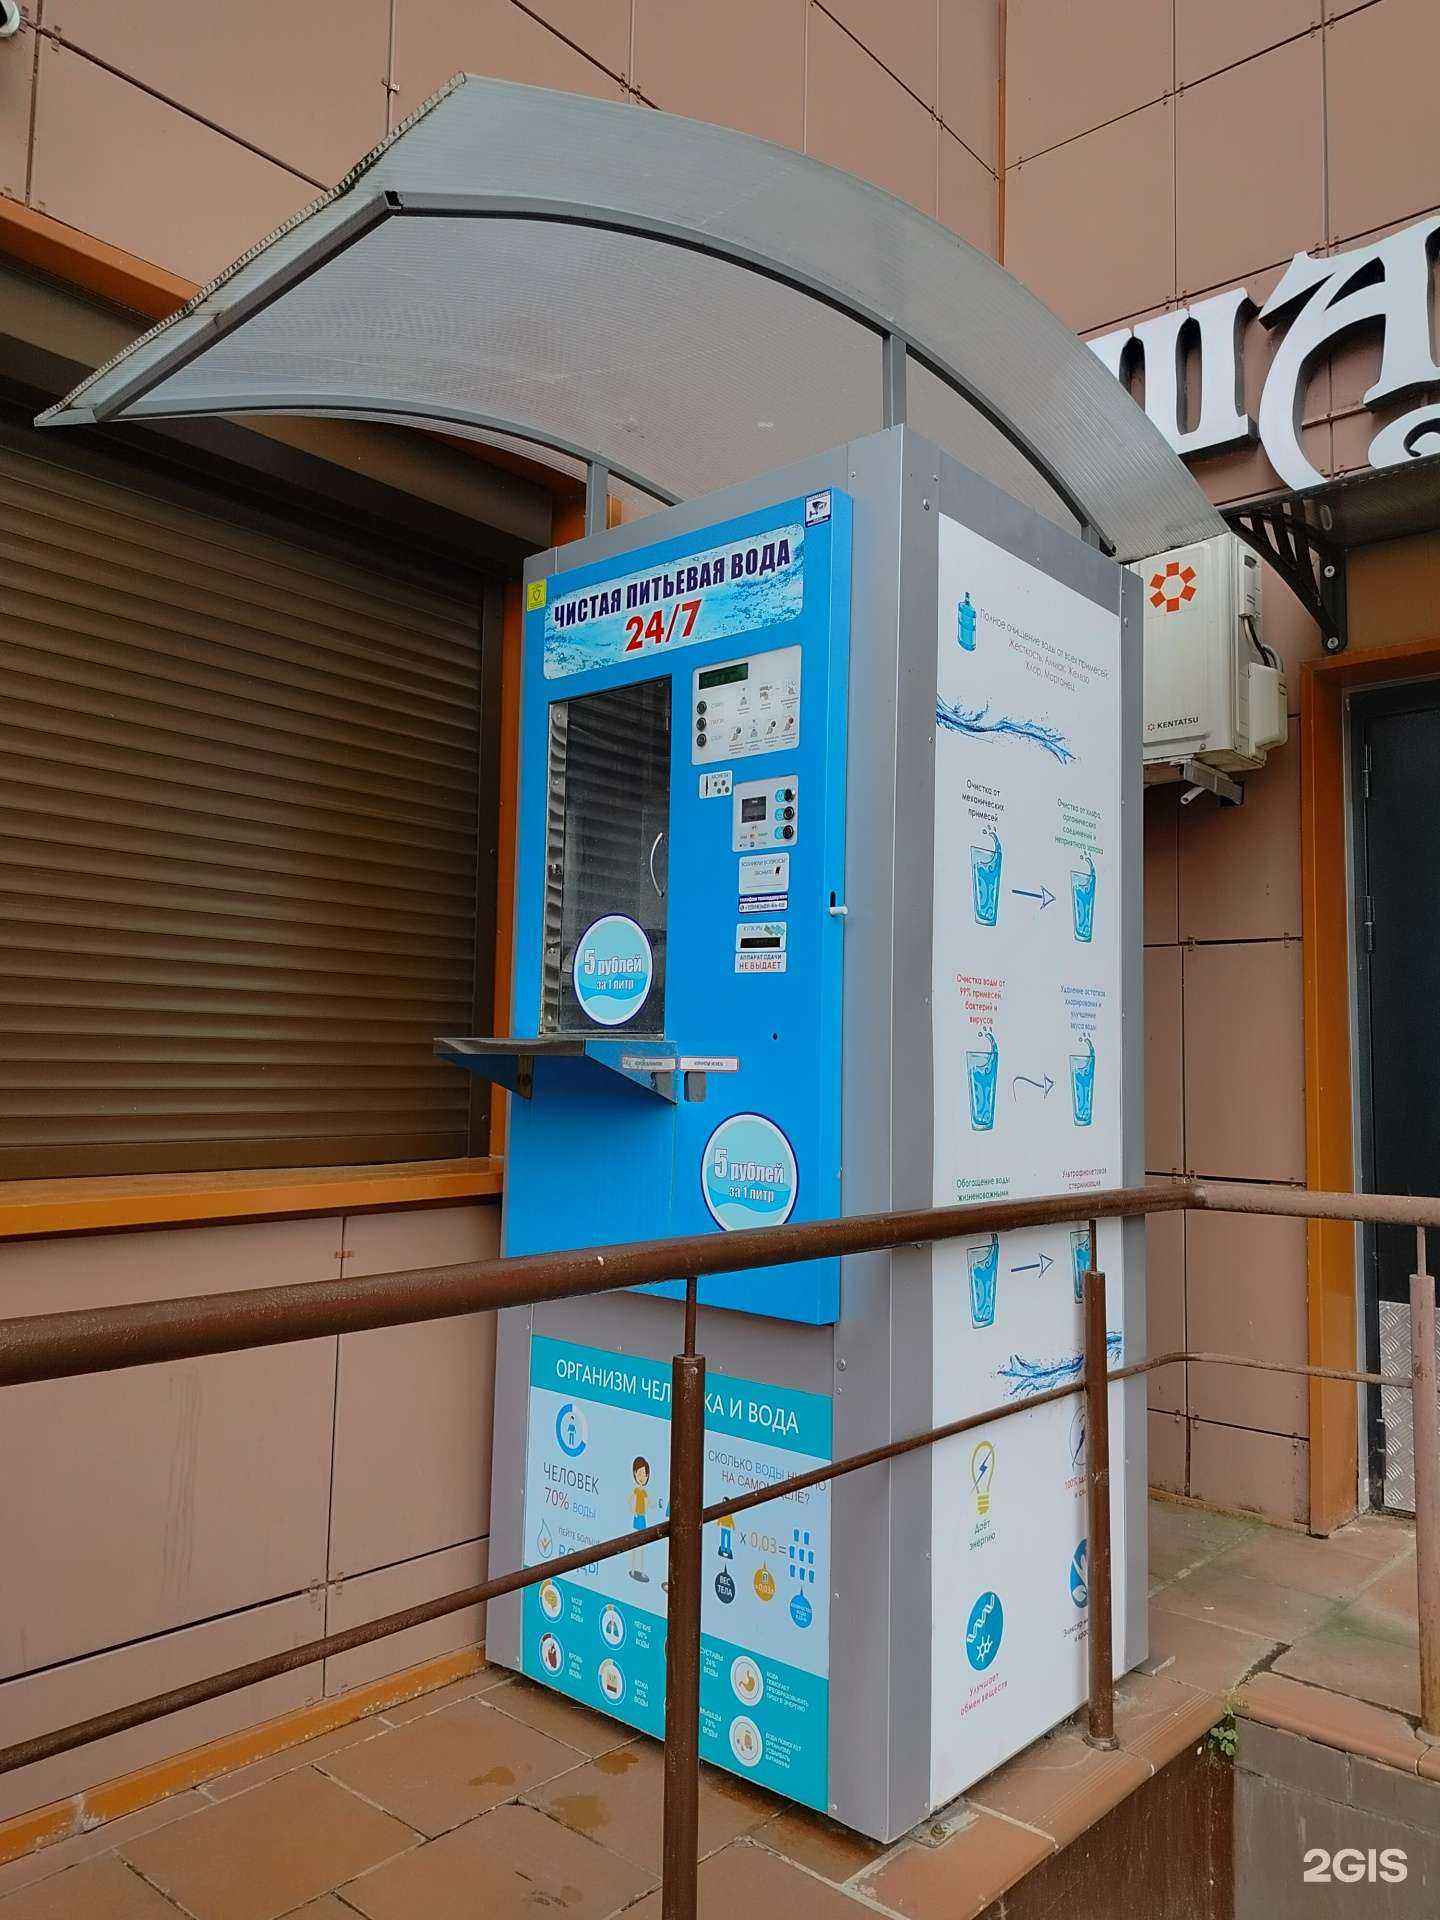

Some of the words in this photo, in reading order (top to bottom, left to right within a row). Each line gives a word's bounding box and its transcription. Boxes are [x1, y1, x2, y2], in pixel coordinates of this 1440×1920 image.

[554, 587, 621, 628] ЧИСТАЯ
[626, 557, 725, 610] ПИТЬЕВАЯ
[731, 538, 791, 581] ВОДА
[625, 599, 703, 651] 24/7
[1157, 716, 1199, 730] KENTATSU
[584, 949, 595, 974] 5
[597, 955, 642, 976] рублей
[596, 981, 606, 990] за
[613, 979, 634, 991] литр
[714, 1148, 728, 1178] 5
[730, 1160, 784, 1184] рублей
[729, 1185, 741, 1198] за
[750, 1189, 774, 1203] литр
[556, 1359, 637, 1395] ОРГАНИЗМ
[730, 1398, 742, 1420] И
[749, 1402, 800, 1435] ВОДА
[543, 1462, 599, 1495] ЧЕЛОВЕК
[708, 1450, 753, 1472] СКОЛЬКО
[755, 1462, 784, 1480] ВОДЫ
[721, 1470, 735, 1485] НА
[544, 1486, 570, 1510] 70%
[572, 1502, 597, 1520] ВОДЫ
